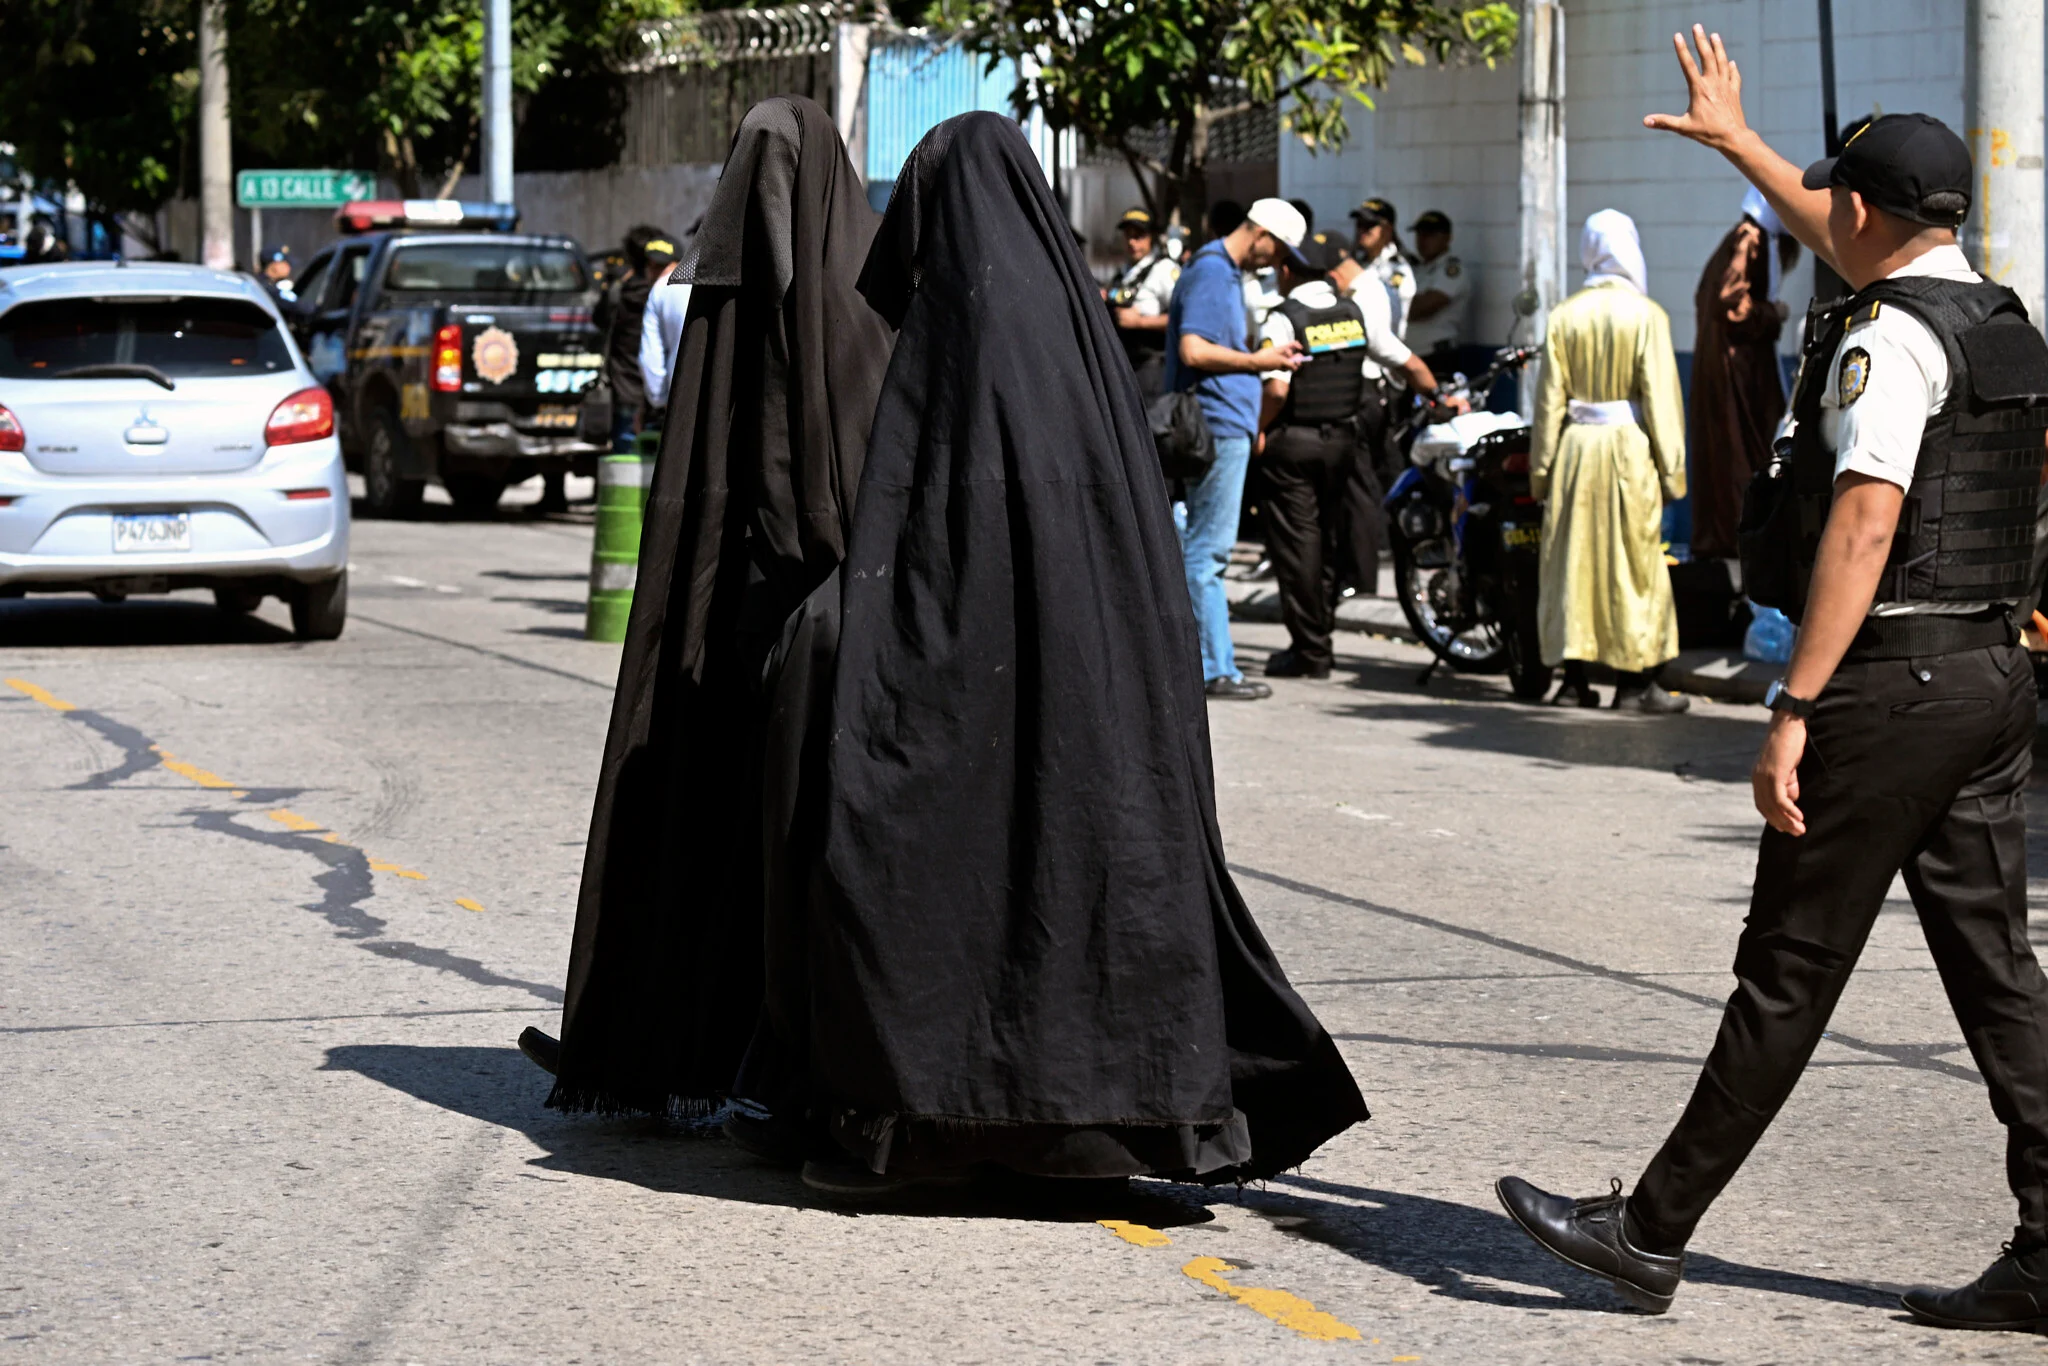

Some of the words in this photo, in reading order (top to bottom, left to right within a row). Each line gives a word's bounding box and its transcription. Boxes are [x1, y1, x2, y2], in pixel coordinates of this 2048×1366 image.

[243, 178, 258, 199] A
[261, 178, 279, 199] 13
[281, 178, 335, 199] CALLE
[118, 521, 187, 540] P476JNP
